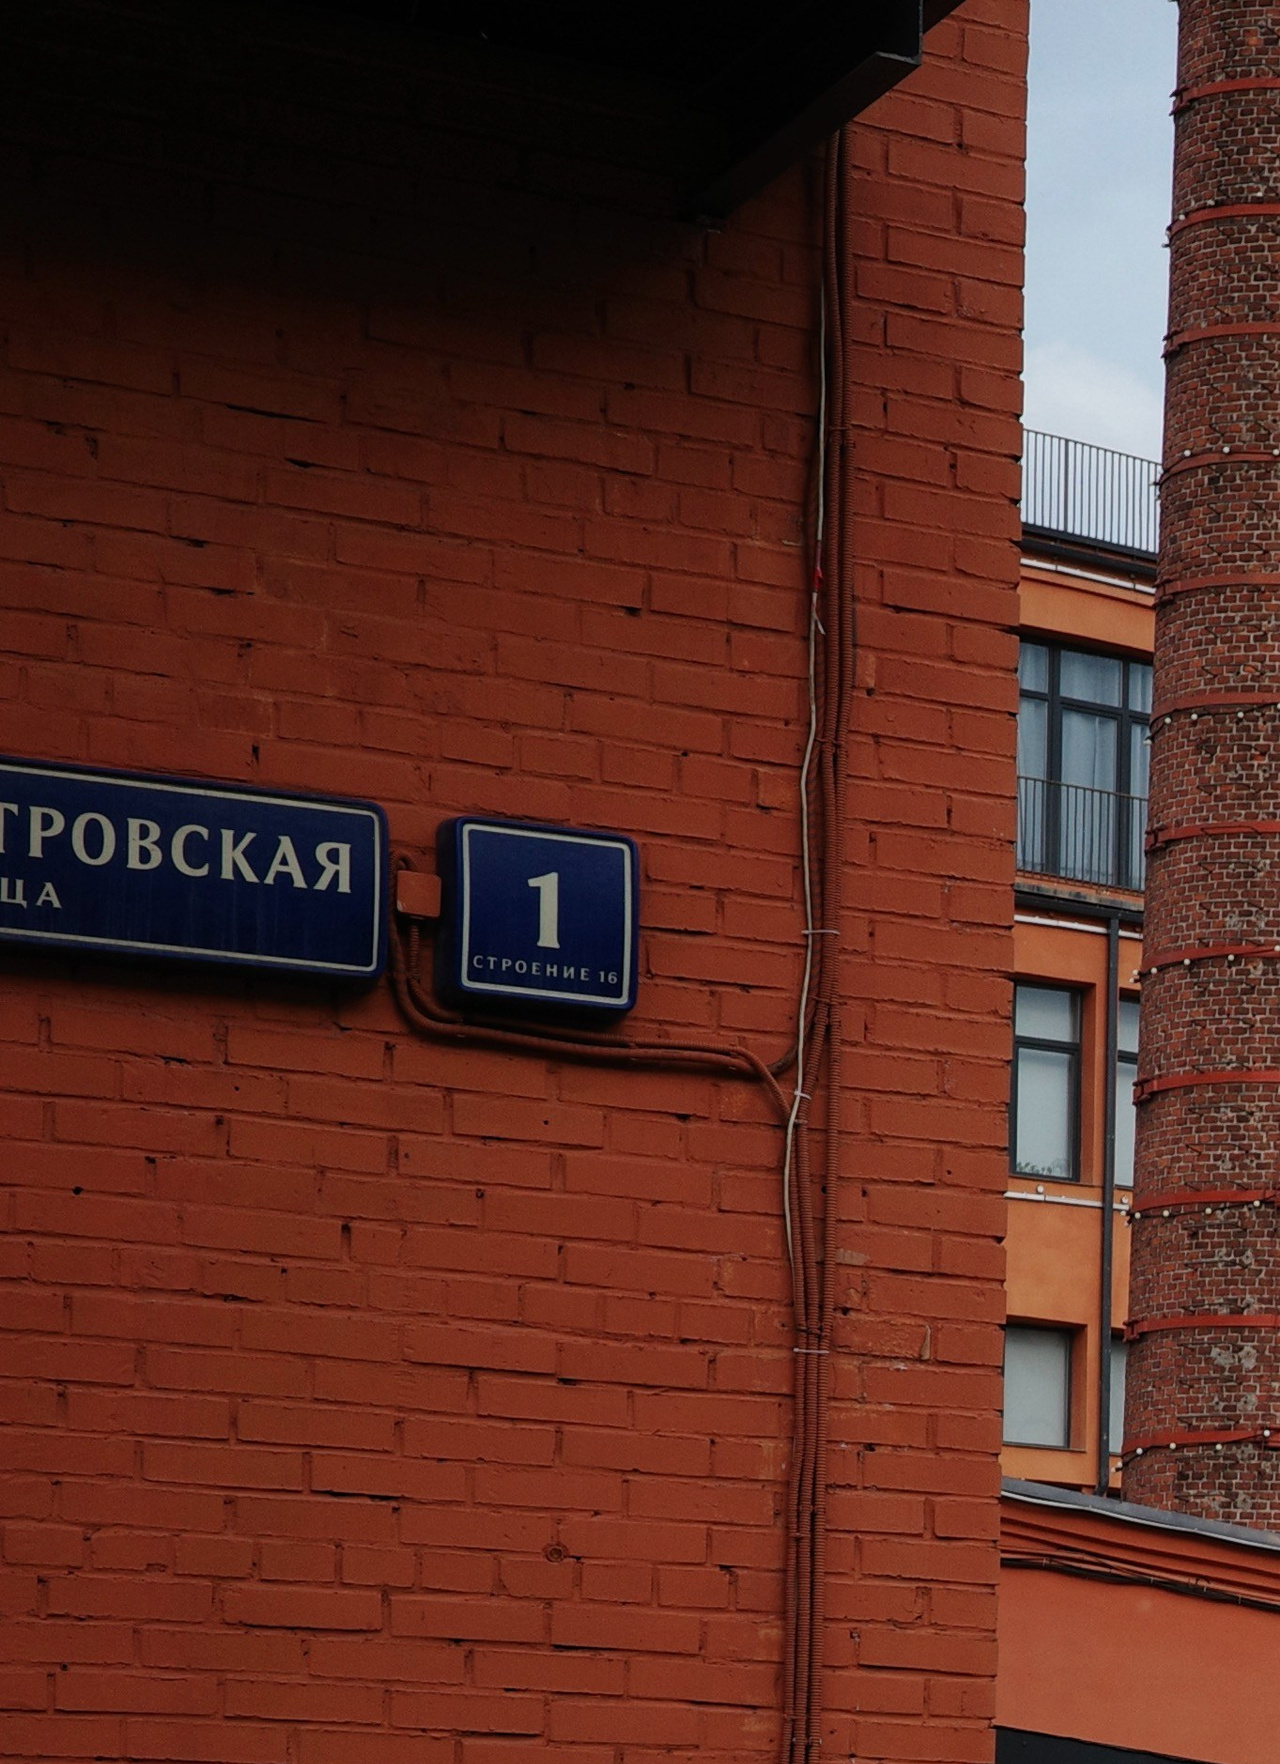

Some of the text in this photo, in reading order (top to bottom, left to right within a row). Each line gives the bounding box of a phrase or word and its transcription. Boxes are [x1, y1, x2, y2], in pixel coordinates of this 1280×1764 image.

[0, 801, 353, 895] ТРОВСКАЯ
[0, 876, 62, 909] ЦА
[527, 871, 560, 950] 1
[472, 955, 619, 985] СТРОЕНИЕ 16
